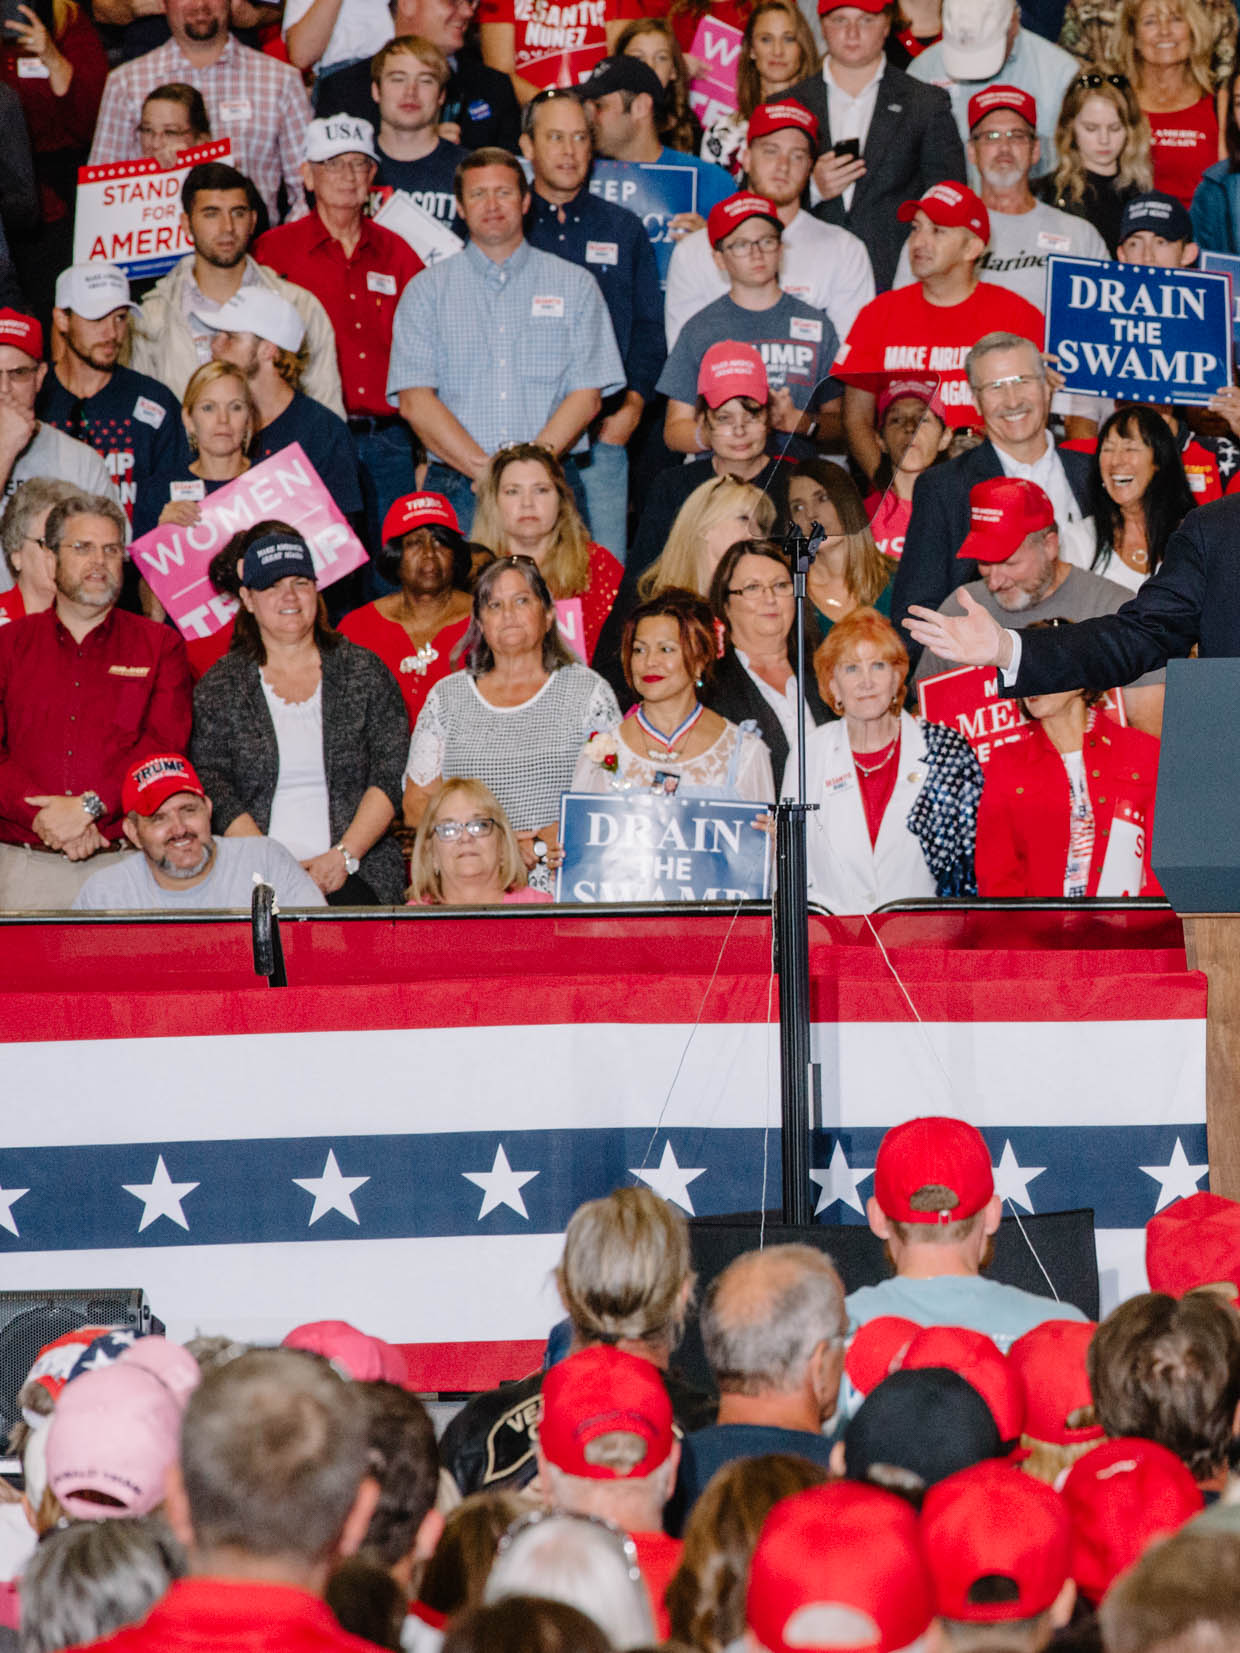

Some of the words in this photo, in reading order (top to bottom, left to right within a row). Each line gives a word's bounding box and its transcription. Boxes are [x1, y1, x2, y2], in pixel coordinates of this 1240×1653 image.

[326, 123, 364, 141] USA
[103, 177, 179, 206] STAND
[588, 180, 637, 203] EEP
[142, 203, 177, 223] FOR
[1069, 275, 1206, 321] DRAIN
[1110, 318, 1162, 346] THE
[884, 346, 928, 371] MAKE
[1058, 340, 1217, 385] SWAMP
[141, 458, 313, 577] WOMEN
[134, 760, 185, 785] TRUMP
[586, 811, 735, 856] DRAIN
[638, 855, 693, 881] THE
